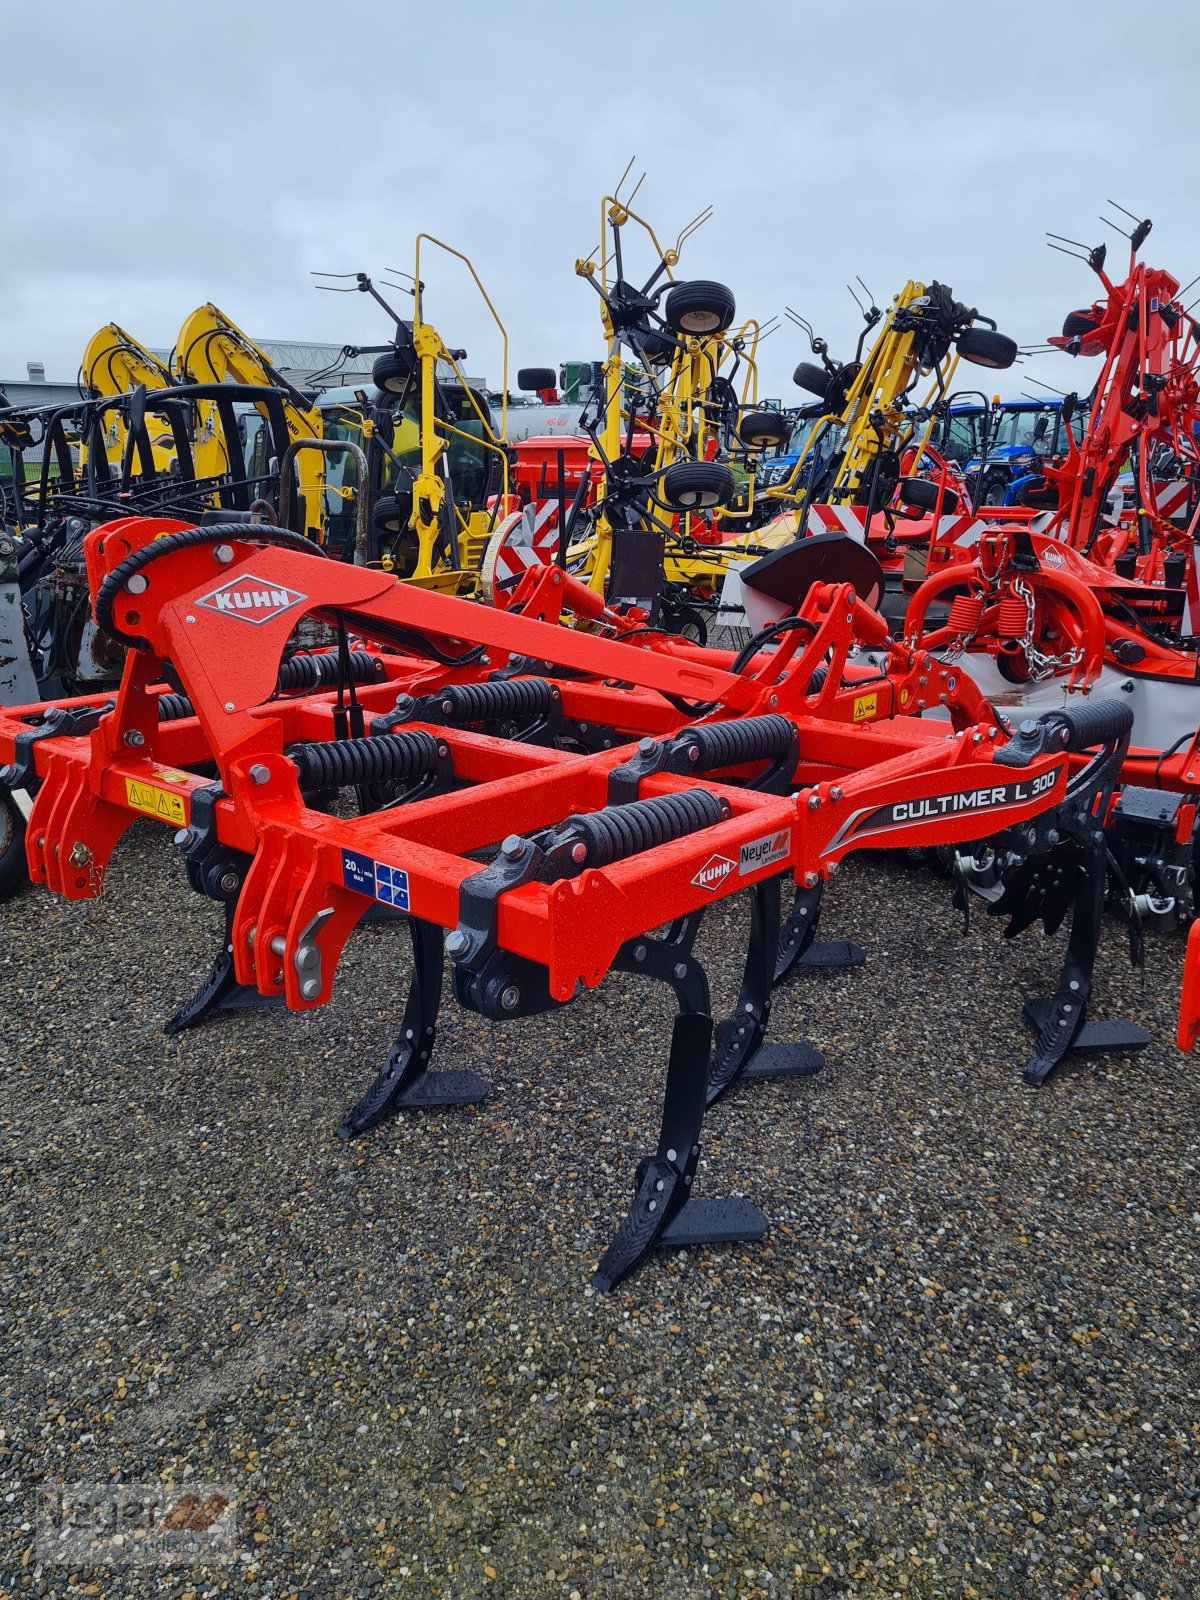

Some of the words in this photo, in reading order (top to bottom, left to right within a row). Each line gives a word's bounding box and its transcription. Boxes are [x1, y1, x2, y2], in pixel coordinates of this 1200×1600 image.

[215, 590, 290, 609] KUHN
[892, 787, 1006, 821] CULTIMER
[1015, 786, 1027, 800] L
[1032, 771, 1055, 795] 300
[741, 841, 772, 863] Neyer
[345, 859, 356, 872] 20
[699, 862, 730, 884] KUHN
[353, 874, 364, 882] MAX
